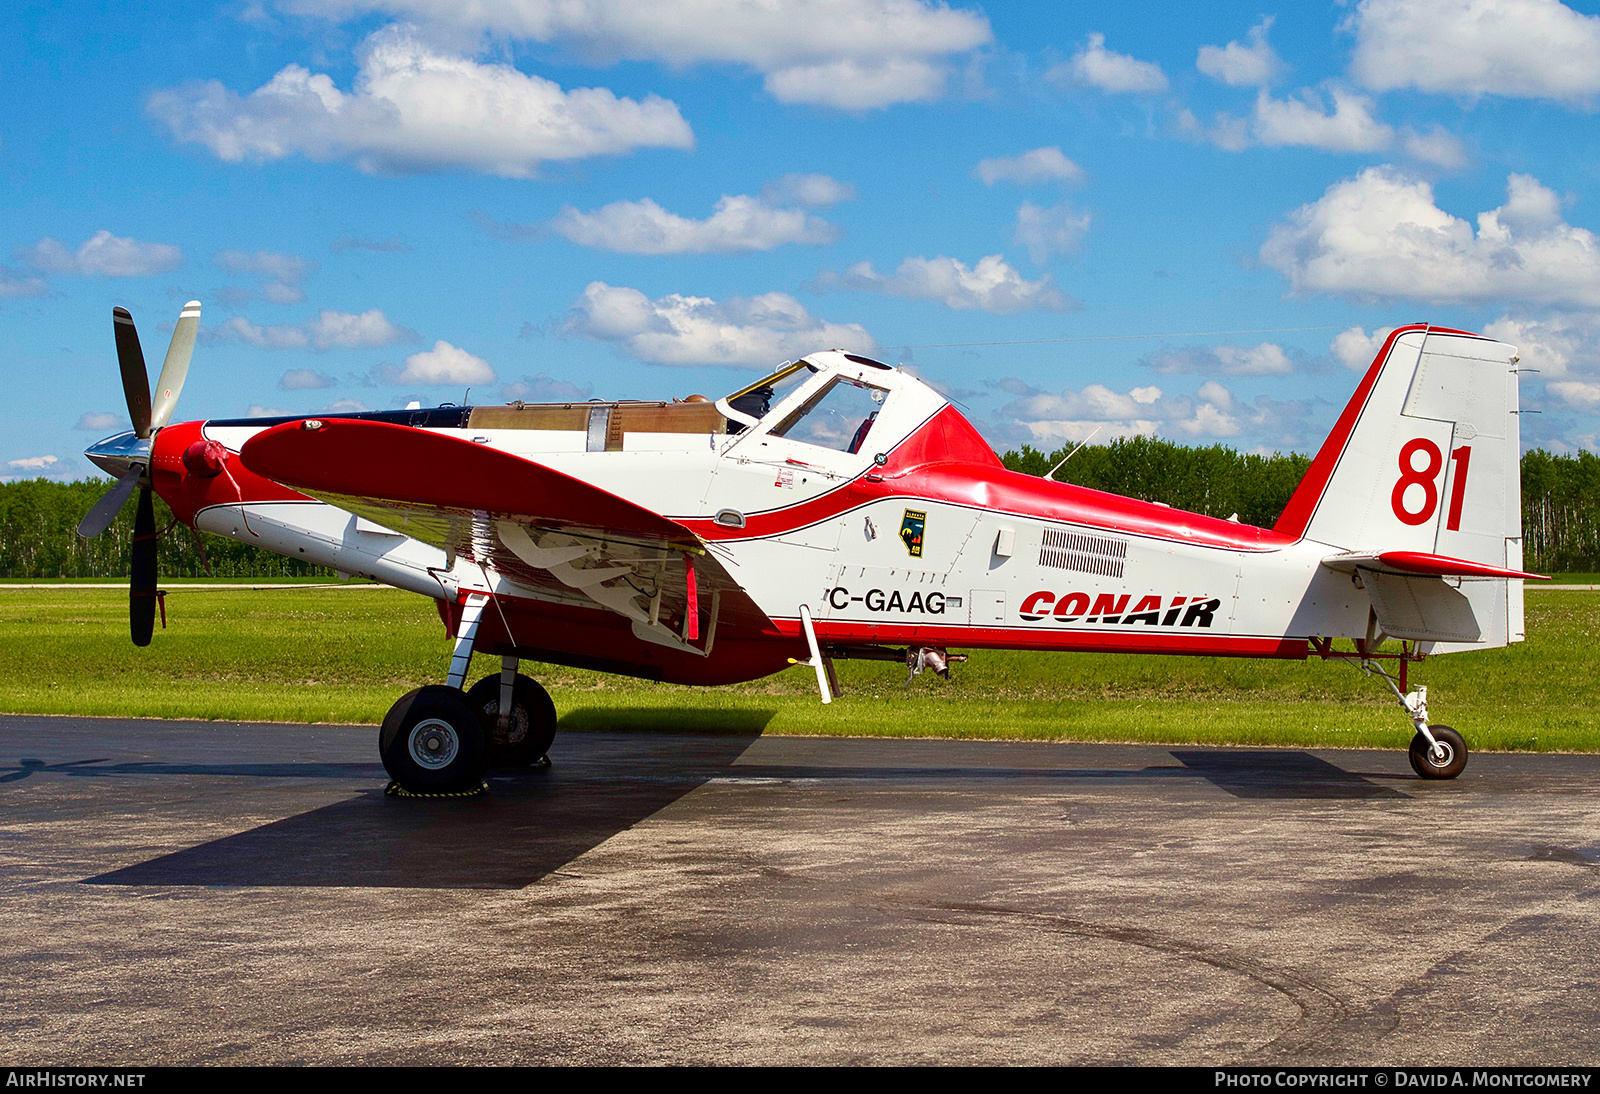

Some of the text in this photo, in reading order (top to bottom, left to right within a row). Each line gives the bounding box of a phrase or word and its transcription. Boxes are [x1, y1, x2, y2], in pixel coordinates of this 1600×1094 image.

[1391, 438, 1471, 531] 81
[829, 587, 945, 614] C-GAAG
[1019, 591, 1220, 627] CONAIR
